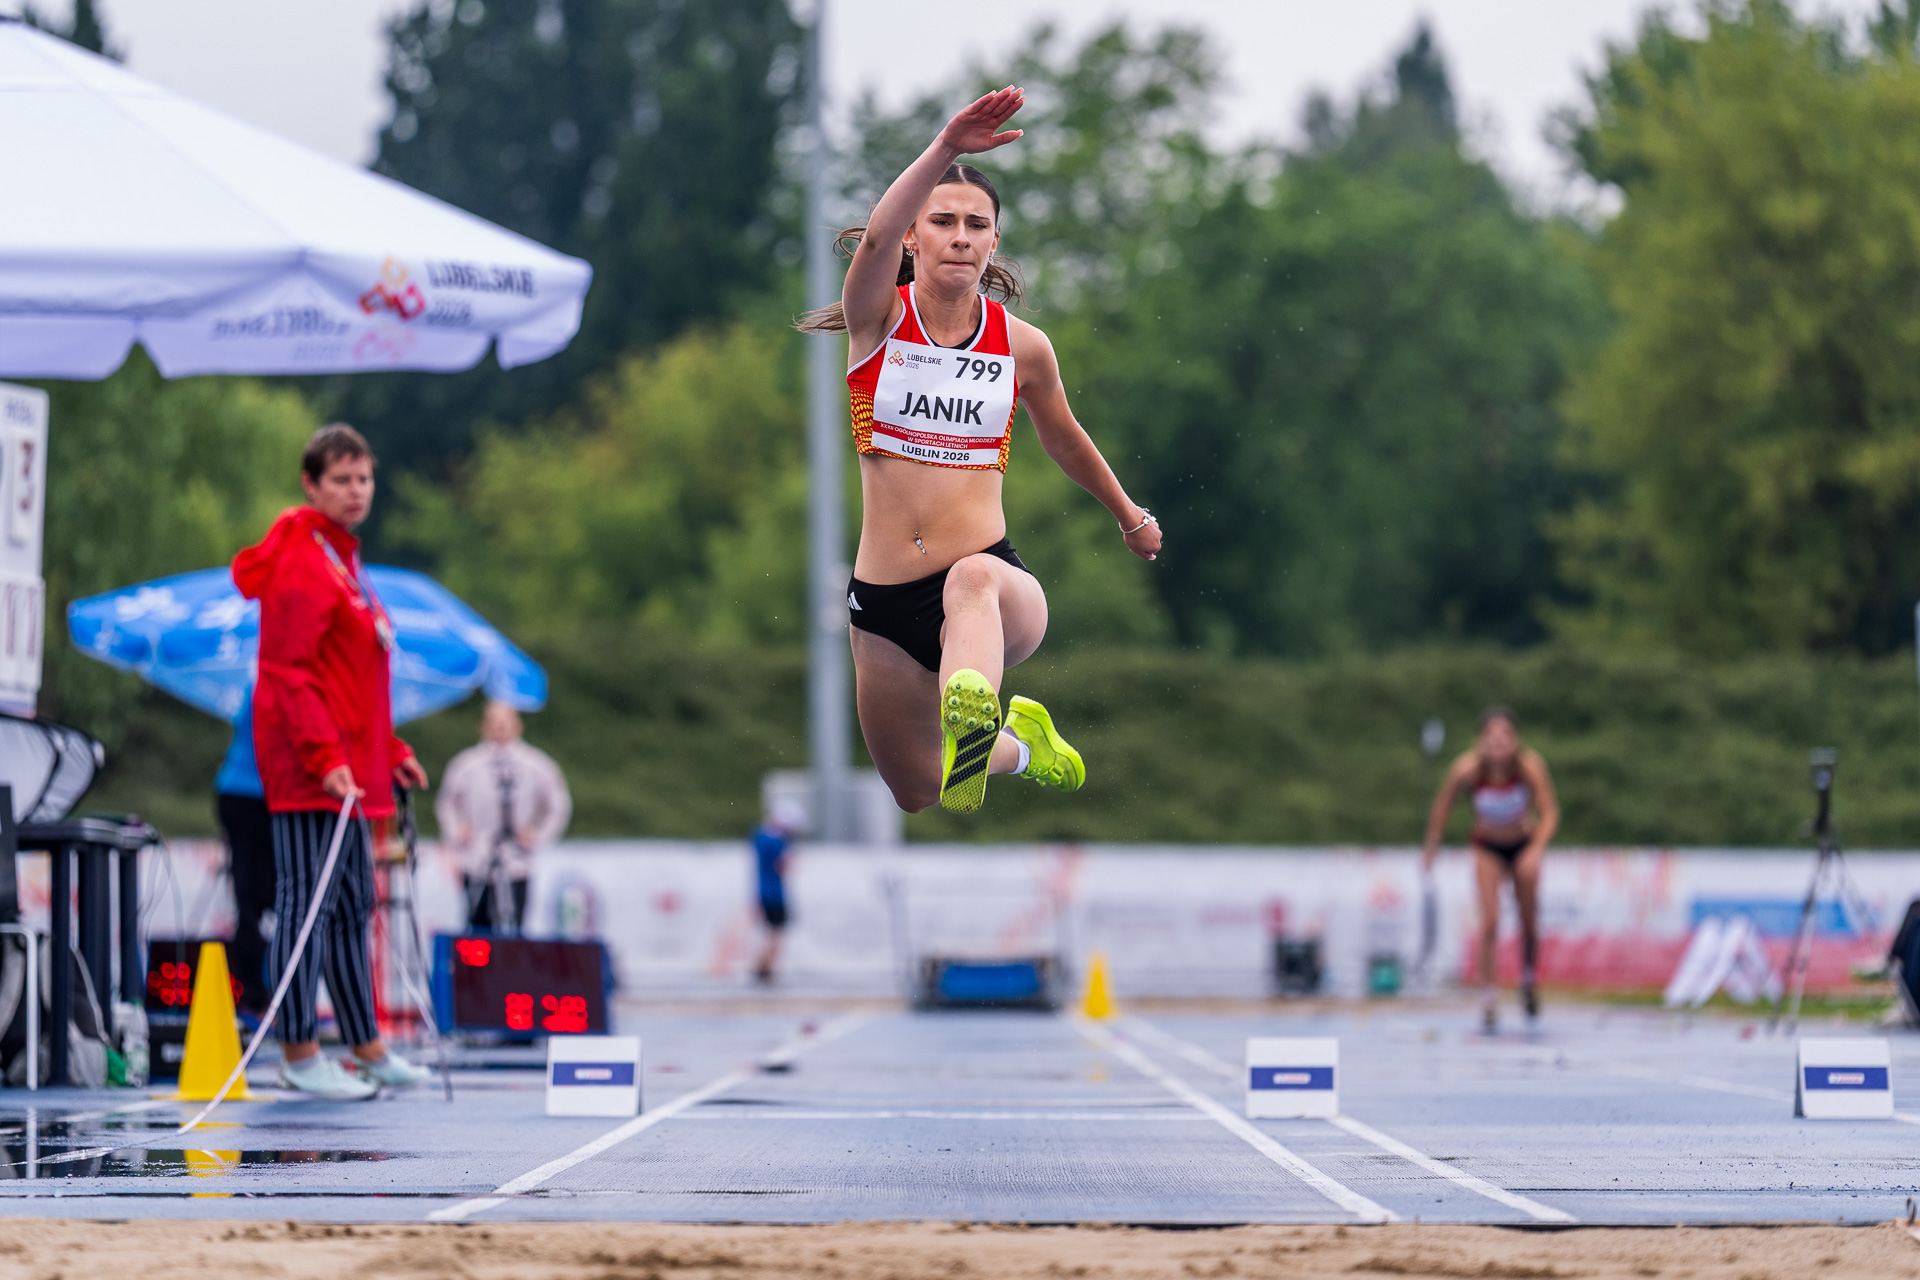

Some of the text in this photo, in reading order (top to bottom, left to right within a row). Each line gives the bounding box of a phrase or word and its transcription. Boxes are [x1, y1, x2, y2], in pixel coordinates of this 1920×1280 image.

[905, 361, 920, 370] 2026
[906, 353, 943, 365] LUBELSKIE
[955, 356, 1003, 383] 799
[898, 391, 985, 426] JANIK
[894, 426, 938, 440] OGÓLNOPOLSKA
[938, 435, 968, 443] OLIMPIADA
[914, 438, 945, 447] SPORTACH
[901, 443, 970, 461] LUBLIN 2026
